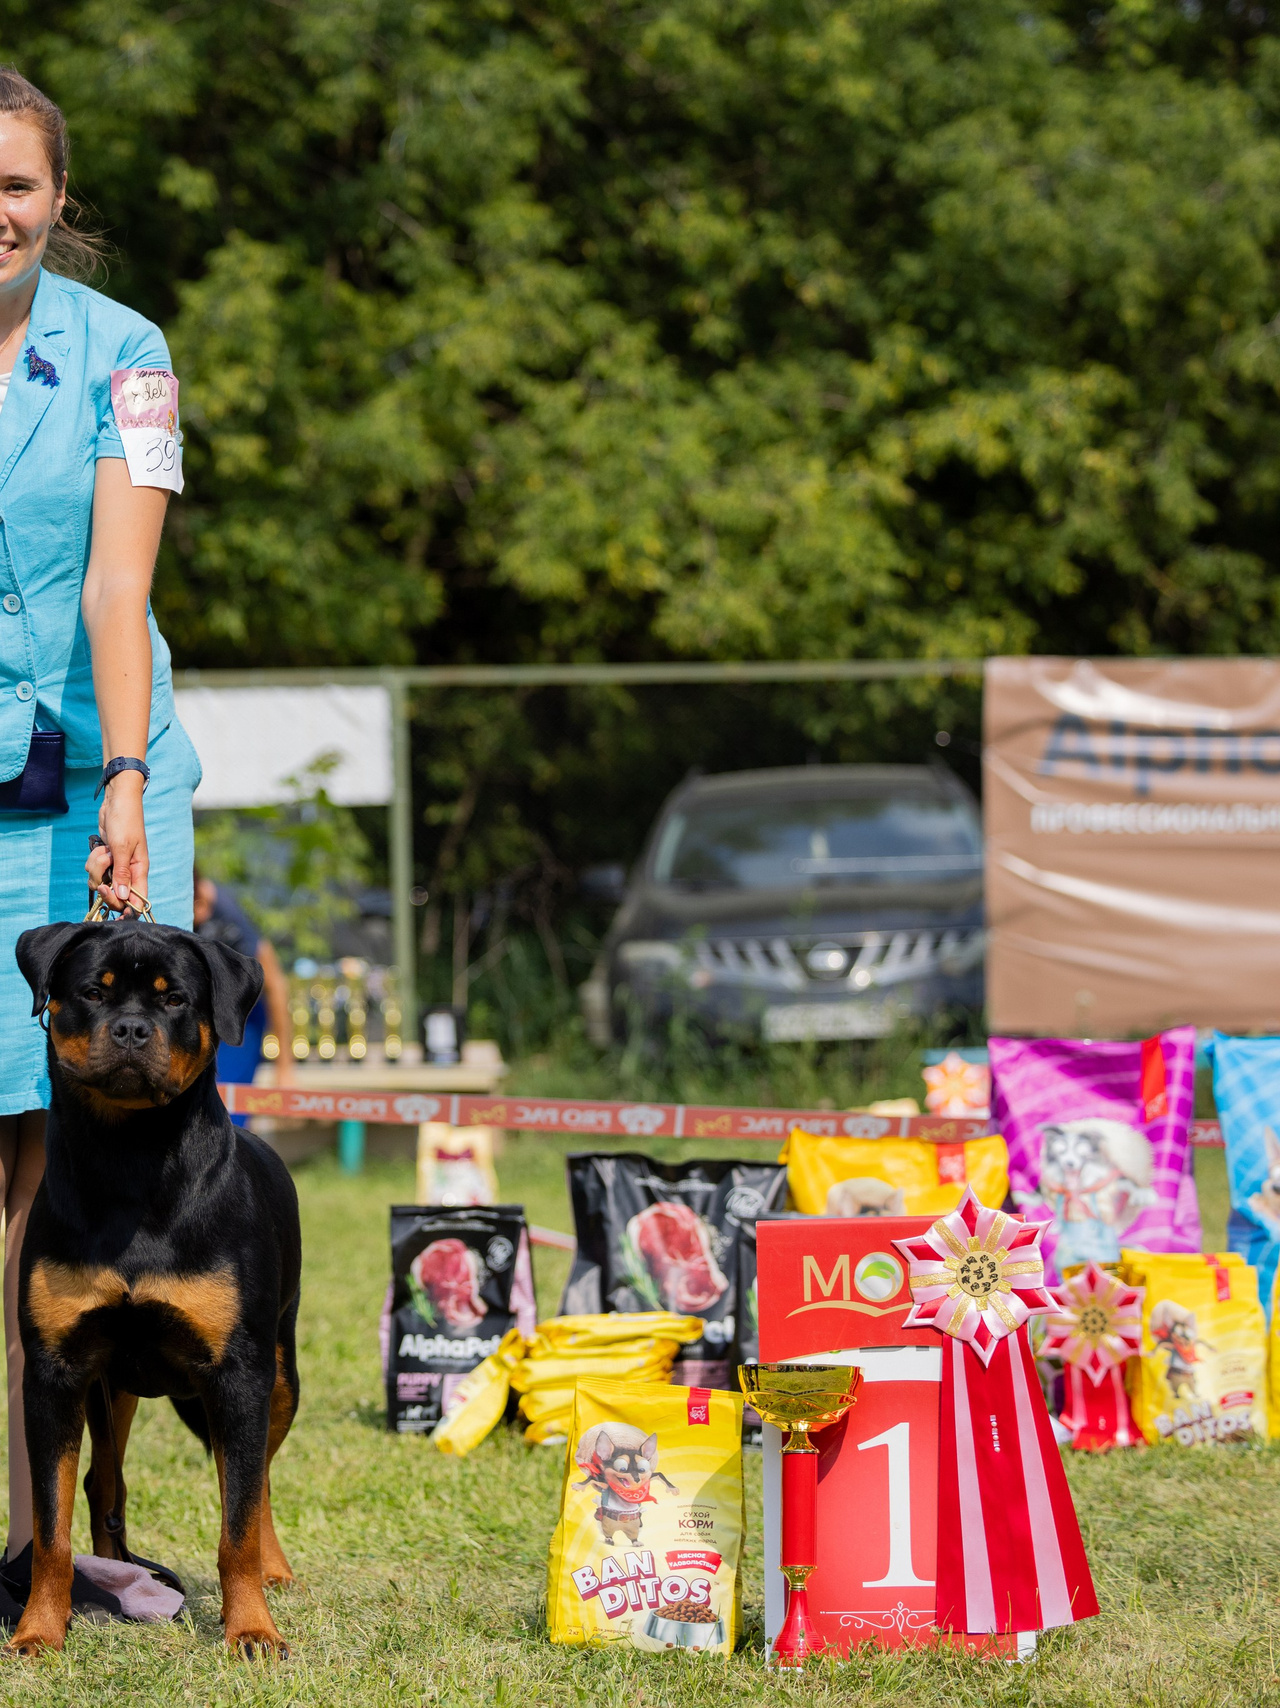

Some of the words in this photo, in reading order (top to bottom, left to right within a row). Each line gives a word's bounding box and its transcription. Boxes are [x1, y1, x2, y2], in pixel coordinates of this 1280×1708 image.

[146, 438, 176, 473] 39
[683, 1511, 710, 1519] СУХОЙ
[857, 1421, 936, 1588] 1
[678, 1519, 714, 1529] КОРМ
[668, 1559, 717, 1572] УДОВОЛЬСТВИЕ
[677, 1552, 707, 1560] МЯСНОЕ
[571, 1550, 660, 1602] BAN
[598, 1575, 712, 1621] DITOS
